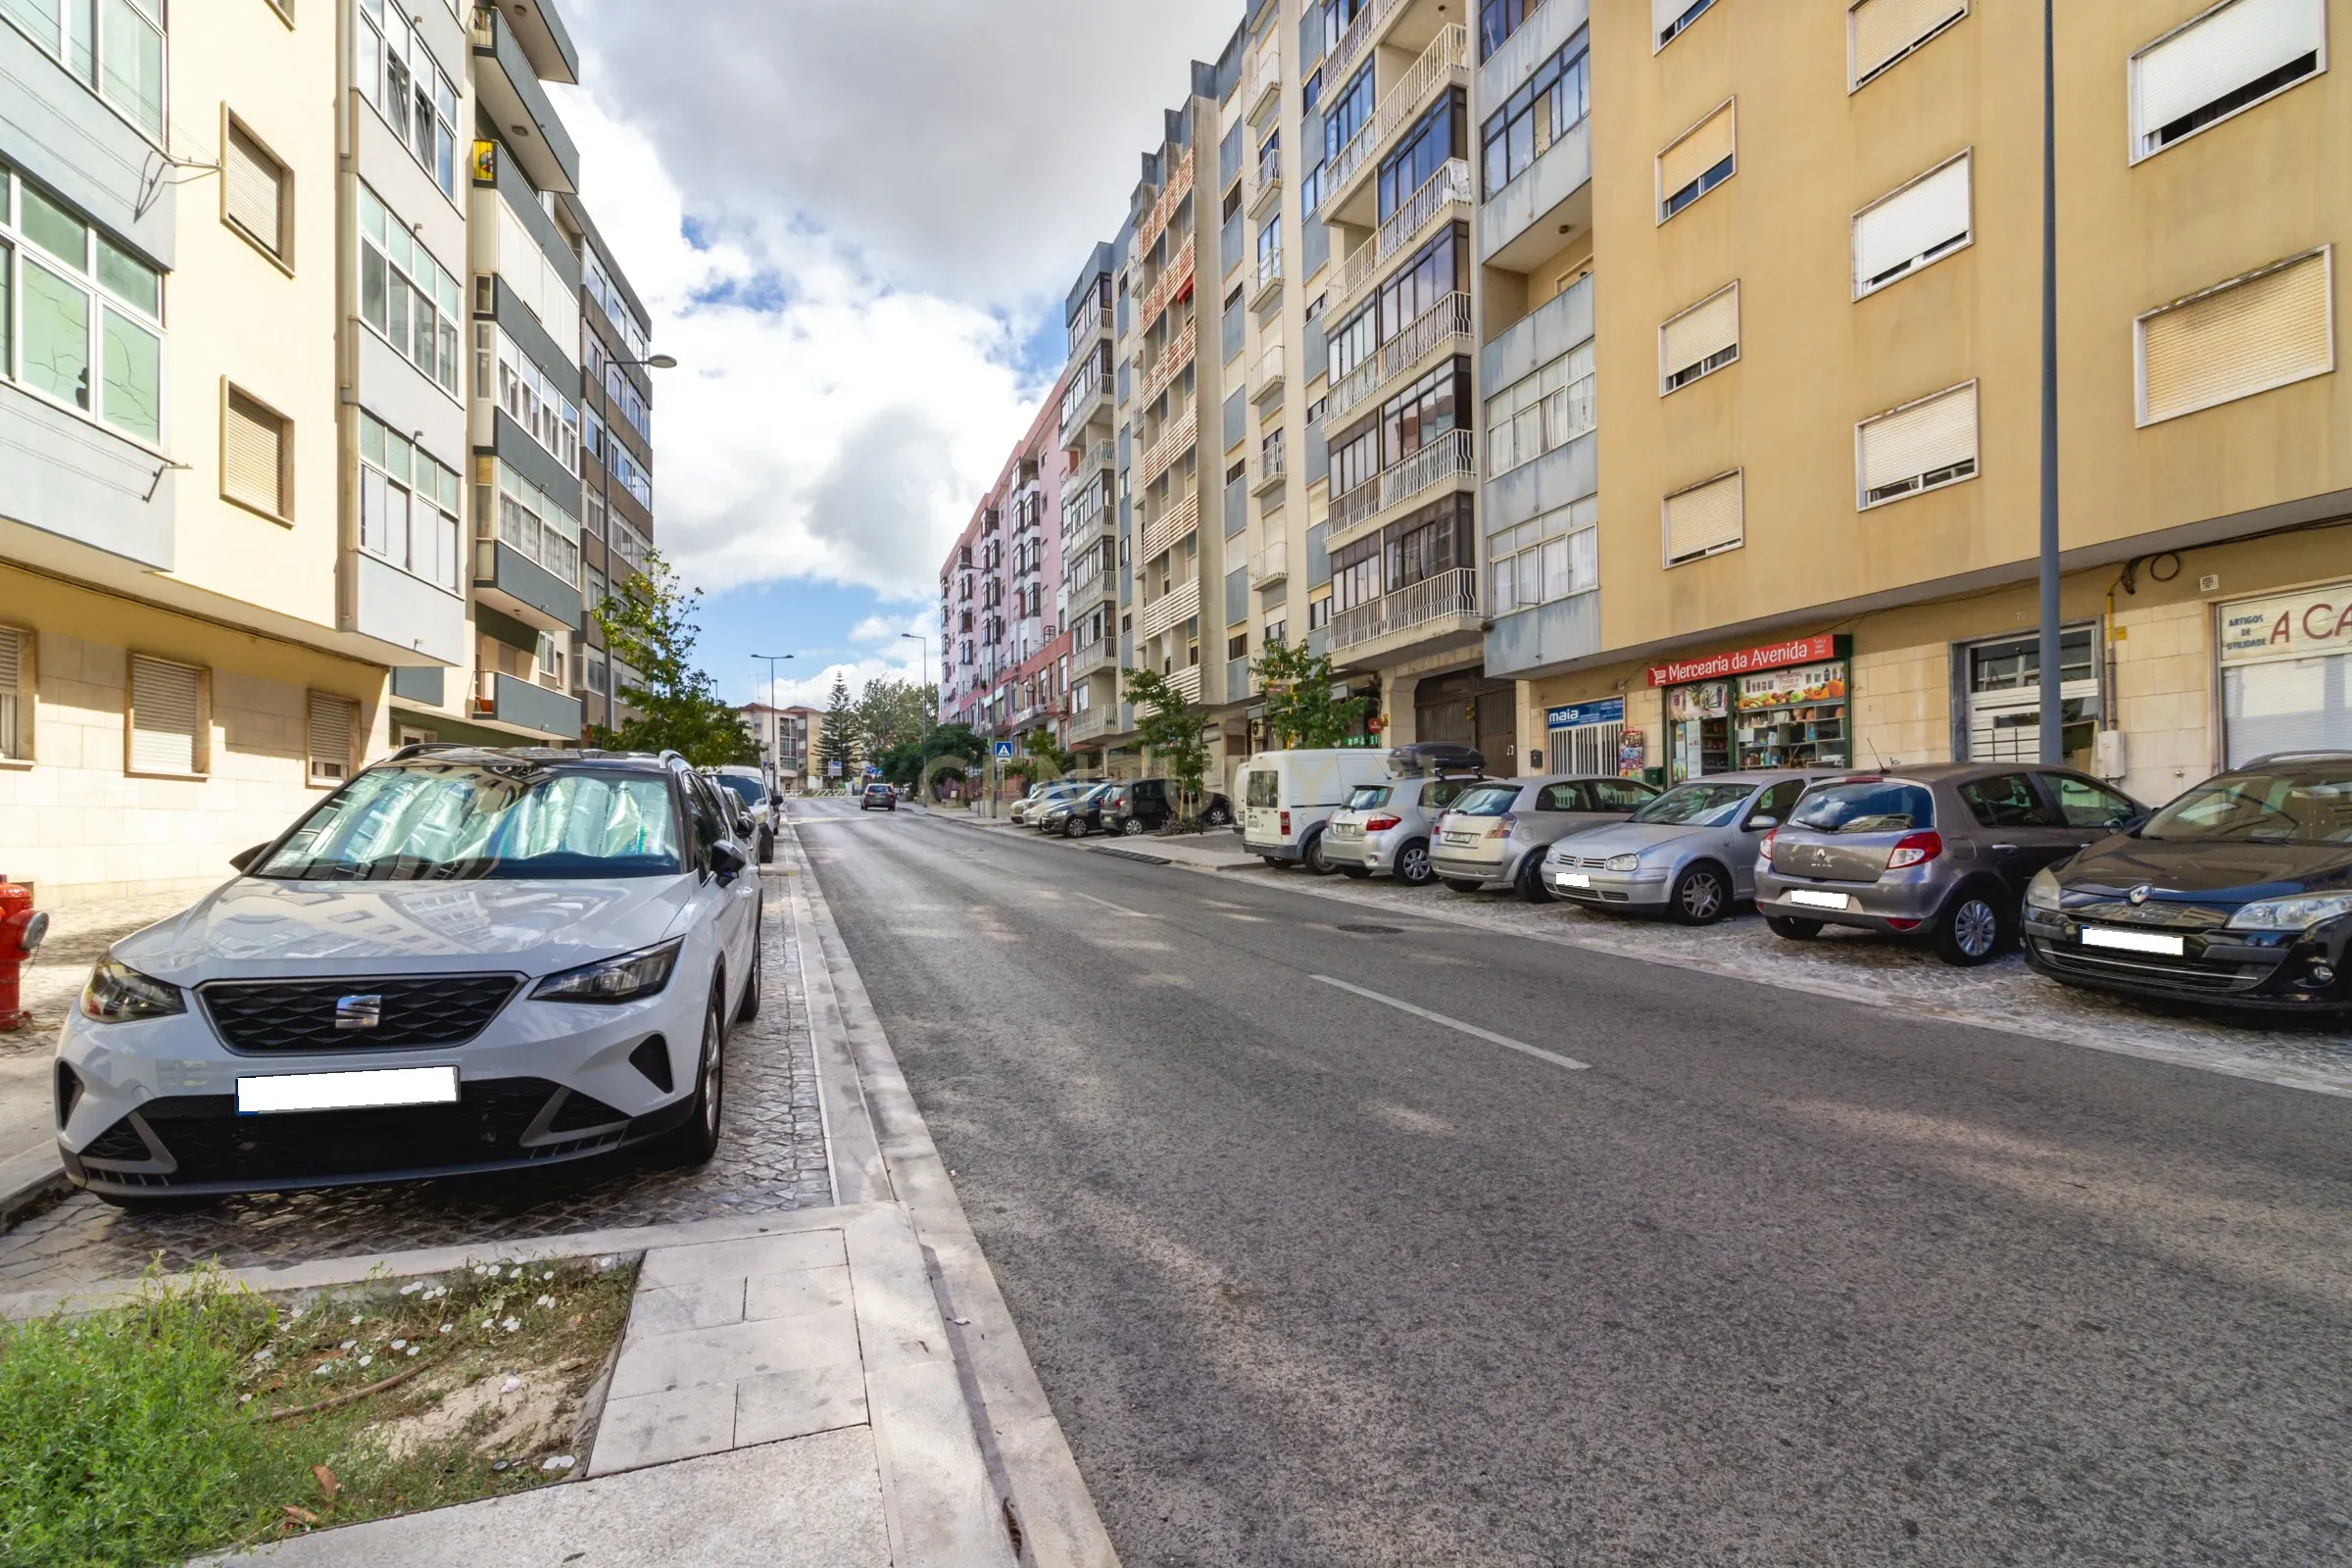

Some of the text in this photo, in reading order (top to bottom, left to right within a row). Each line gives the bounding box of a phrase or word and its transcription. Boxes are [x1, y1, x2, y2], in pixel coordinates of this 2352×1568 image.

[2016, 612, 2028, 621] 70
[2229, 614, 2264, 627] ARTIGOS
[2241, 628, 2251, 637] DE
[2270, 610, 2290, 645] A
[2227, 638, 2267, 650] UTILIDADE
[1668, 642, 1808, 681] Mercearia da Avenida
[1548, 709, 1579, 722] maia
